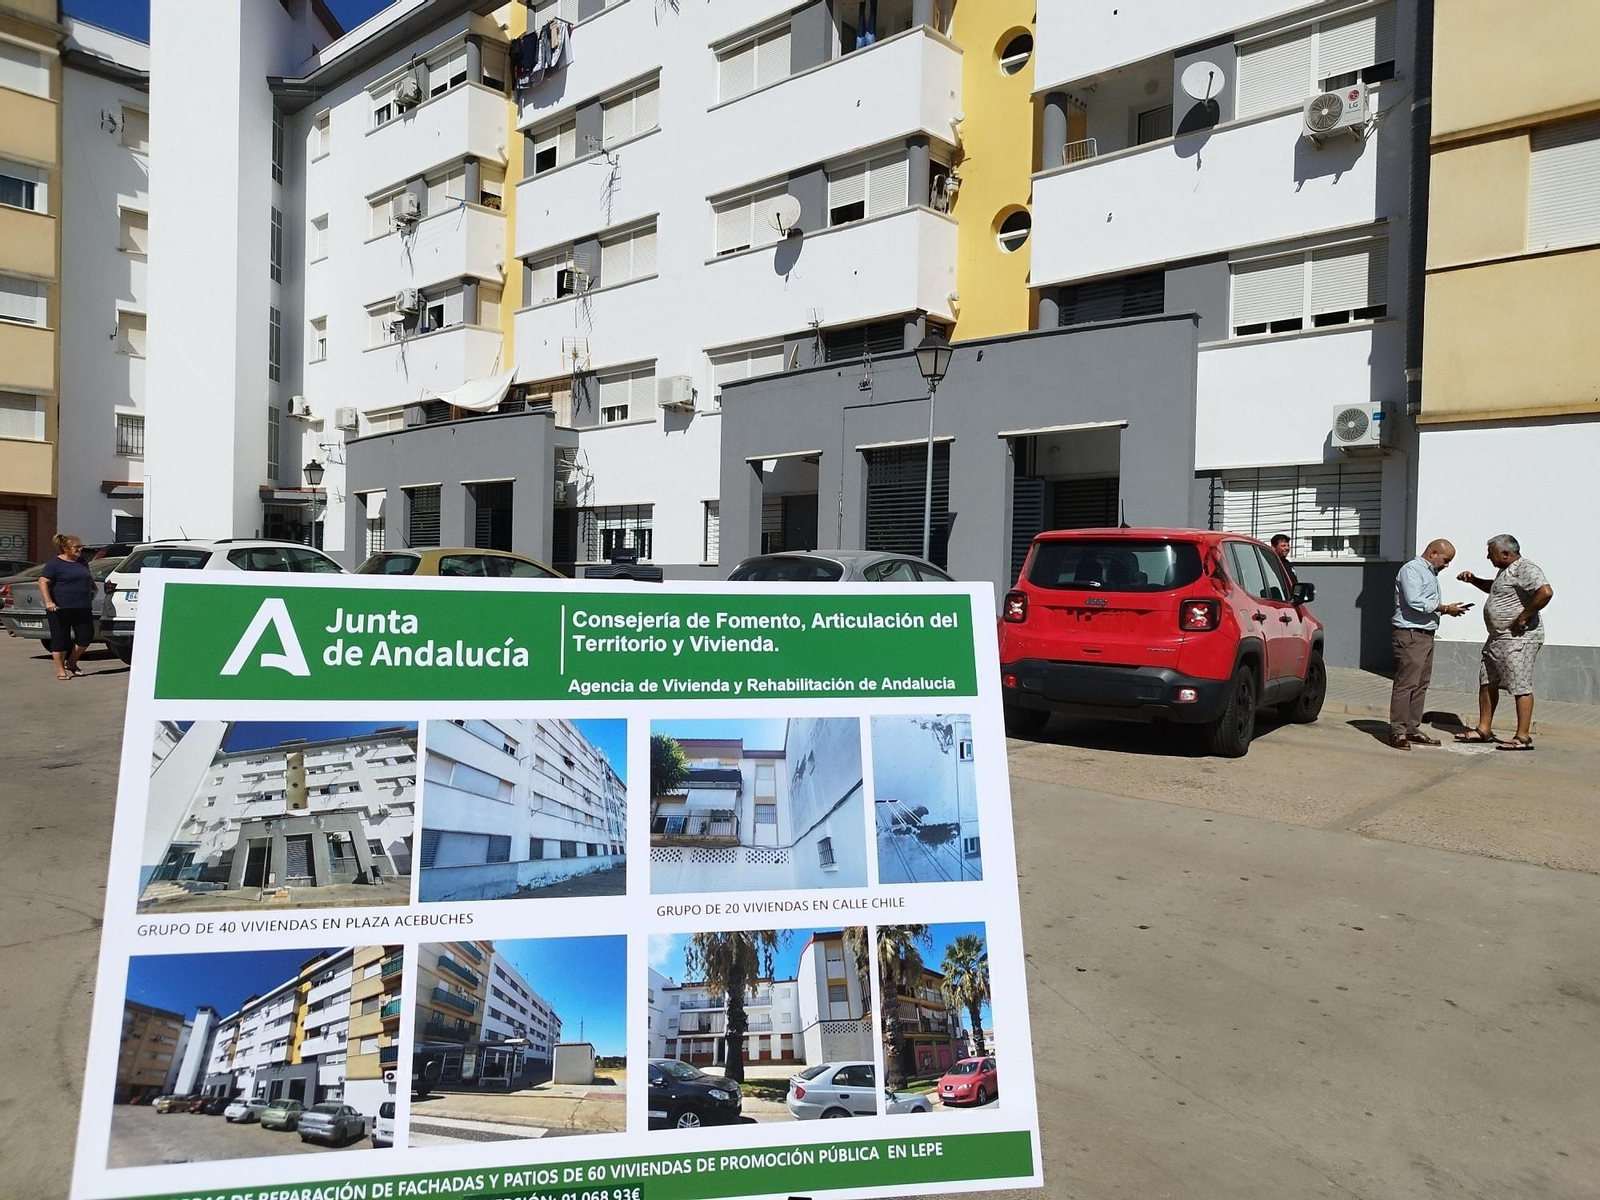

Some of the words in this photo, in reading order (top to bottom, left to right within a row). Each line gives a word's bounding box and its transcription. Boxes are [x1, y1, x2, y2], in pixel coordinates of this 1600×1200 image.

[325, 607, 419, 634] Junta
[572, 610, 681, 632] Consejería
[686, 612, 710, 629] de
[716, 612, 806, 632] Fomento,
[811, 612, 925, 629] Articulación
[930, 612, 958, 628] del
[323, 638, 362, 667] de
[370, 636, 530, 667] Andalucía
[572, 634, 667, 652] Territorio
[672, 639, 685, 657] y
[690, 635, 780, 652] Vivienda.
[568, 679, 635, 696] Agencia
[638, 679, 659, 693] de
[662, 678, 730, 693] Vivienda
[733, 681, 743, 695] y
[747, 678, 855, 692] Rehabilitación
[858, 677, 878, 691] de
[881, 676, 956, 691] Andalucía
[656, 904, 701, 917] GRUPO
[705, 904, 721, 915] DE
[724, 903, 740, 914] 20
[743, 901, 809, 913] VIVIENDAS
[813, 900, 829, 911] EN
[832, 898, 868, 910] CALLE
[871, 897, 906, 909] CHILE
[137, 923, 191, 937] GRUPO
[195, 922, 215, 934] DE
[218, 922, 236, 934] 40
[241, 918, 318, 933] VIVIENDAS
[322, 917, 341, 930] EN
[346, 915, 390, 929] PLAZA
[394, 912, 474, 927] ACEBUCHES
[372, 1182, 394, 1198] DE
[398, 1174, 485, 1197] FACHADAS
[489, 1173, 500, 1189] Y
[503, 1169, 559, 1188] PATIOS
[563, 1167, 584, 1183] DE
[587, 1165, 606, 1182] 60
[610, 1159, 692, 1179] VIVIENDAS
[696, 1157, 716, 1173] DE
[720, 1147, 815, 1171] PROMOCIÓN
[819, 1145, 880, 1163] PÚBLICA
[888, 1145, 907, 1159] EN
[911, 1142, 943, 1158] LEPE
